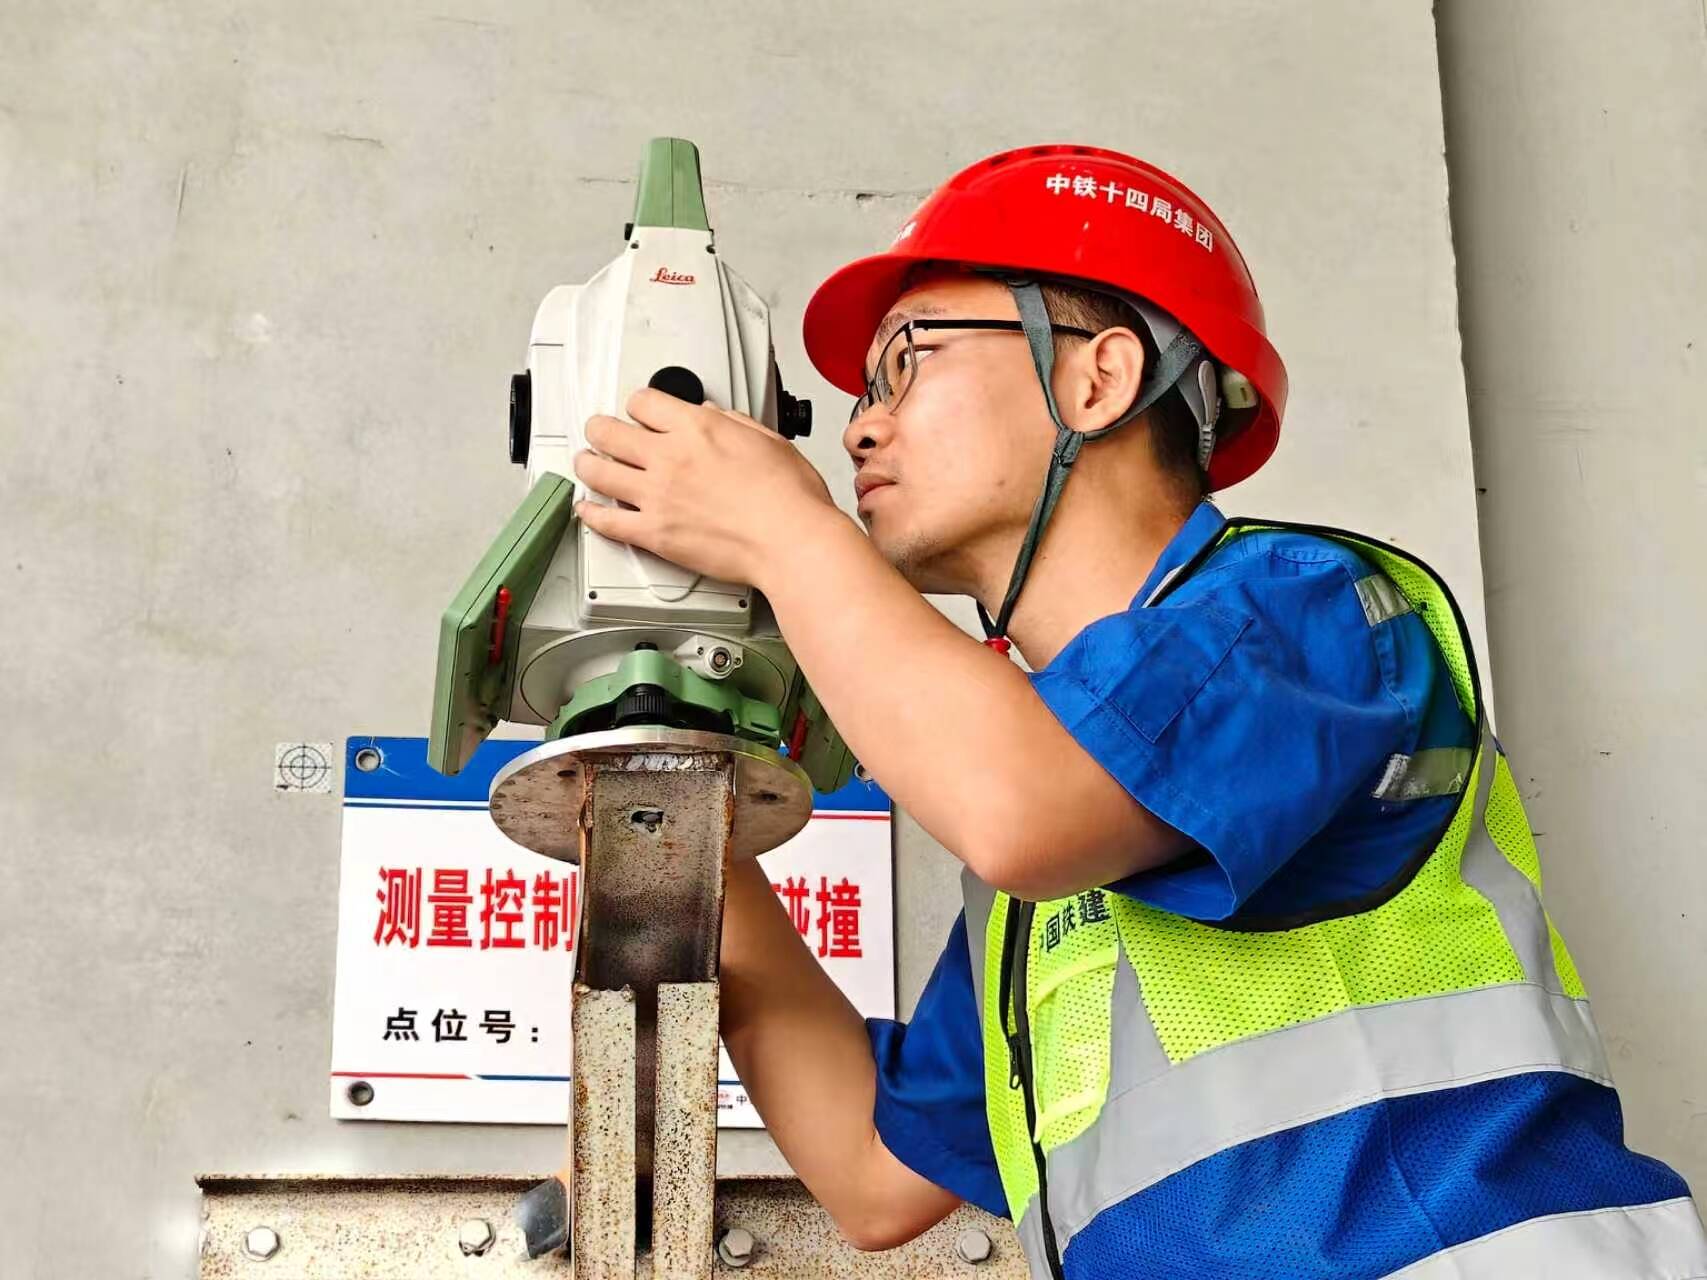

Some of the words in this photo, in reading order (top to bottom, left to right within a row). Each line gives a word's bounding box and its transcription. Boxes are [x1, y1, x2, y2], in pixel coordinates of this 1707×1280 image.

[1045, 173, 1214, 253] 中铁十四局集团
[649, 266, 696, 286] Leica
[373, 865, 578, 952] 测量控制
[1039, 889, 1112, 954] 国铁建
